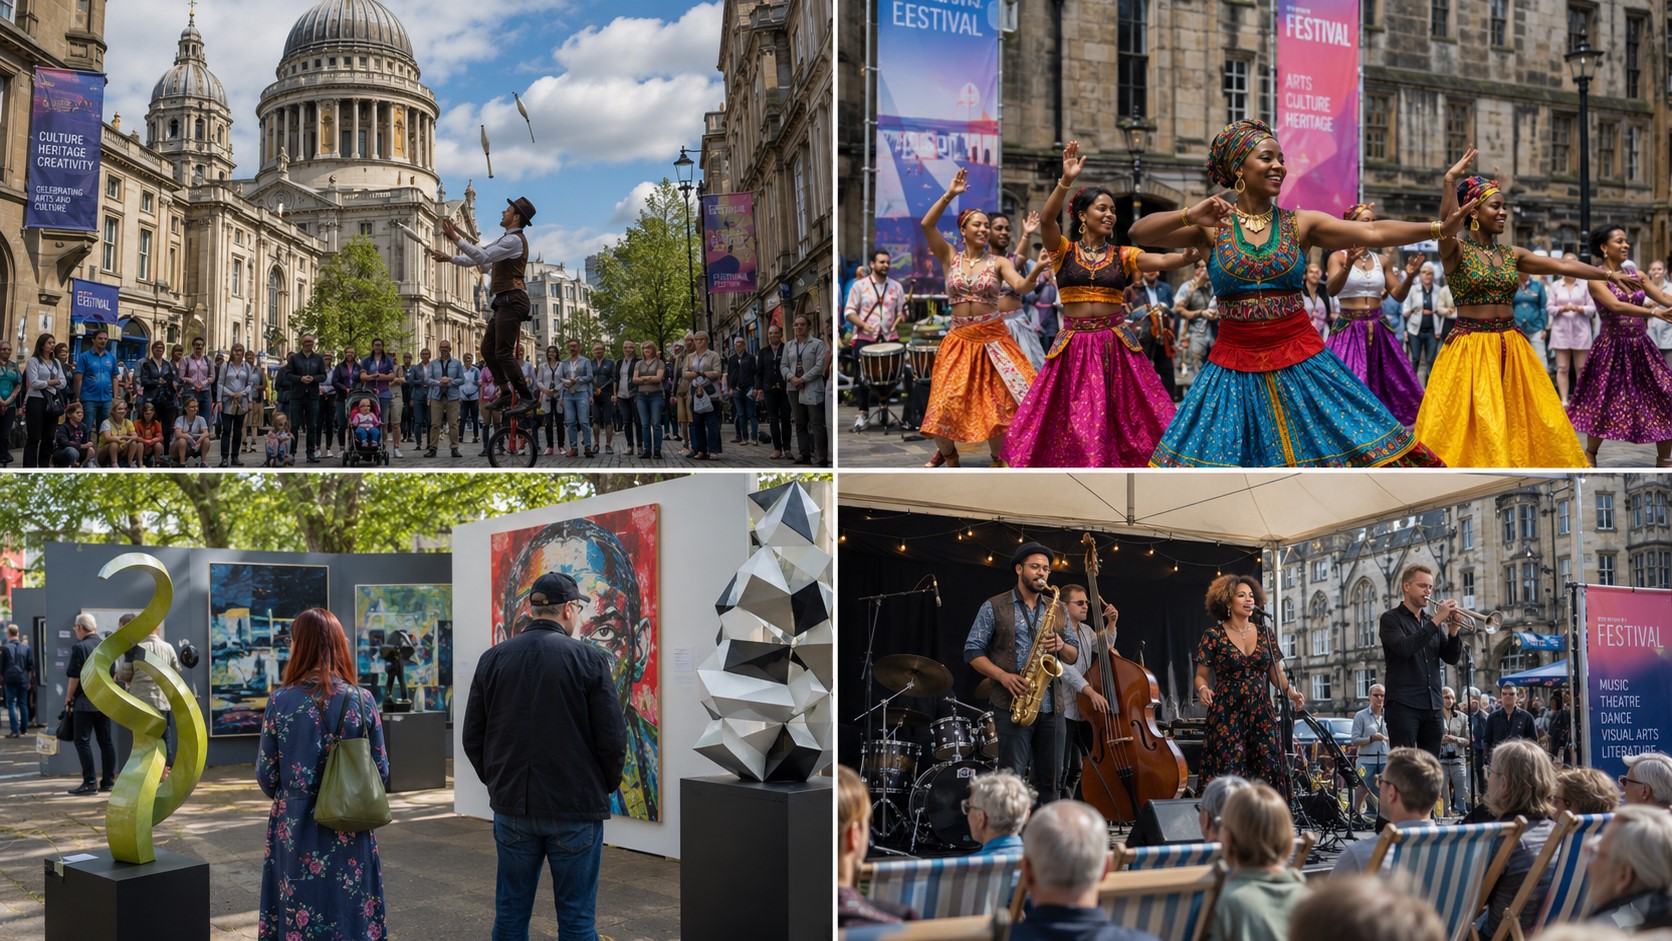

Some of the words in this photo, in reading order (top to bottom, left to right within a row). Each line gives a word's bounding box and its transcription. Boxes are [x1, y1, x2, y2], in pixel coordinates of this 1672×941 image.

[893, 1, 983, 37] EESTIVAL
[1286, 13, 1352, 47] FESTIVAL
[1286, 73, 1312, 91] ARTS
[1285, 93, 1331, 113] CULTURE
[1285, 112, 1333, 132] HERITAGE
[39, 131, 84, 145] CULTURE
[38, 144, 86, 158] HERITAGE
[37, 156, 94, 170] CREATIVITY
[34, 194, 54, 203] ARTS
[34, 202, 67, 212] CULTURE
[1597, 624, 1664, 648] FESTIVAL
[1599, 679, 1629, 691] MUSIC
[1600, 696, 1641, 708] THEATRE
[1601, 712, 1633, 724] DANCE
[1601, 728, 1634, 741] VISUAL
[1636, 728, 1659, 741] ARTS
